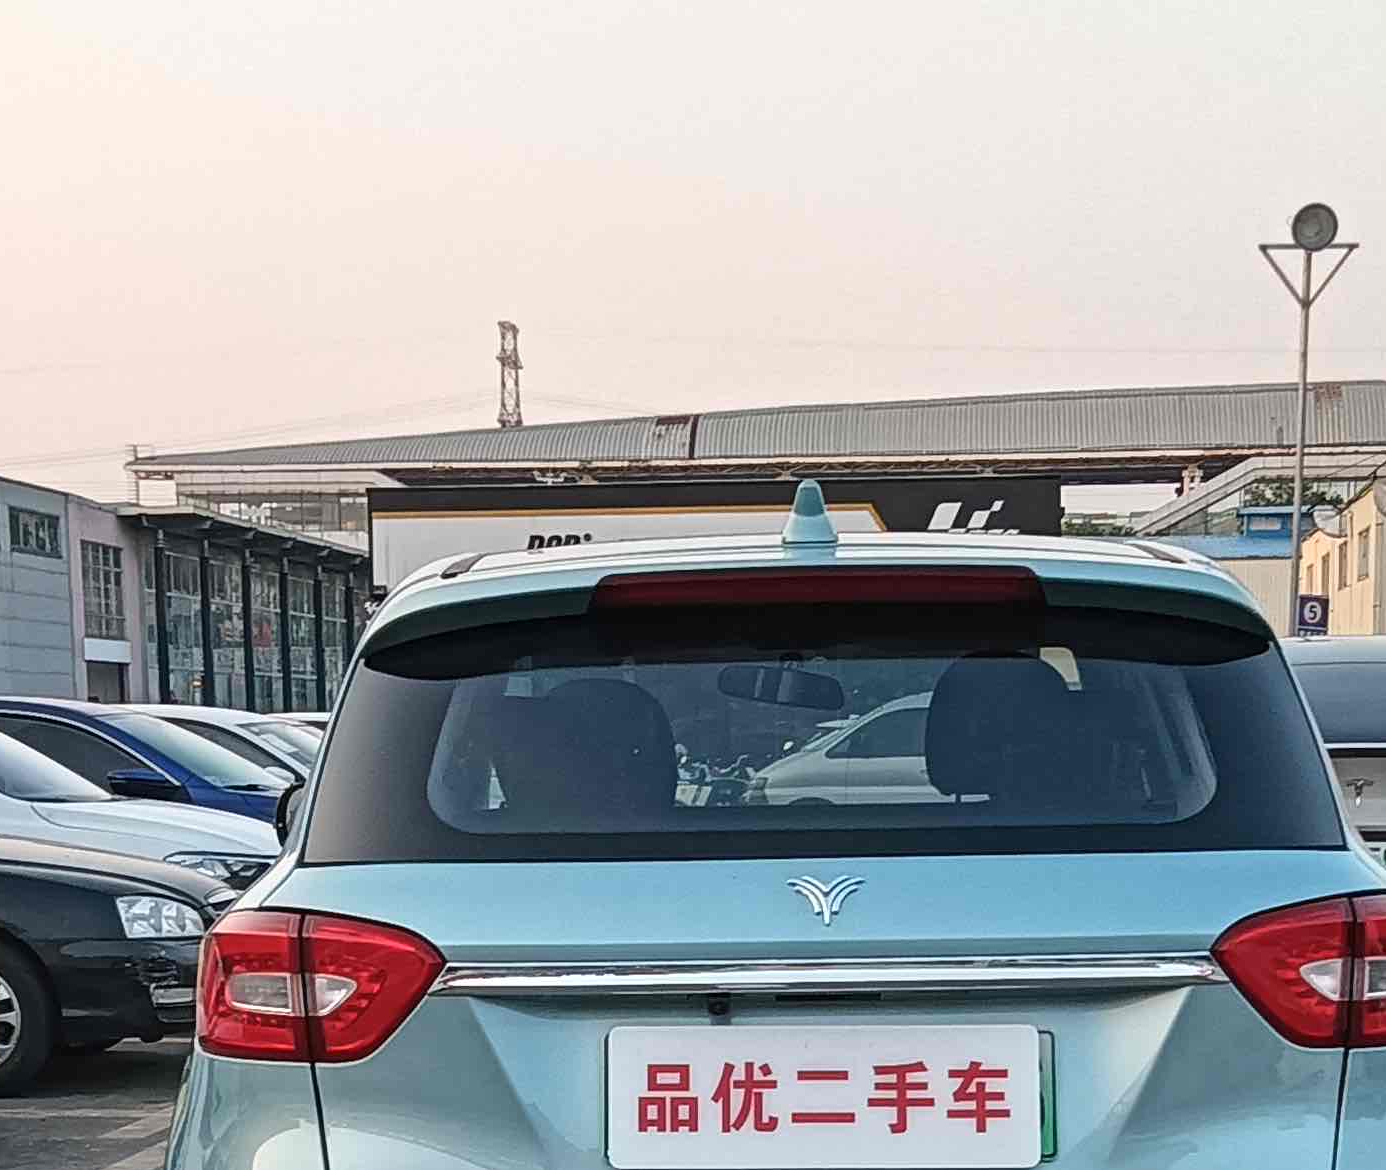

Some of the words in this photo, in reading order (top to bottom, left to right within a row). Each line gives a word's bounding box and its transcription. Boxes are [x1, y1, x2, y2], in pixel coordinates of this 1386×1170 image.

[638, 1061, 1011, 1133] 品优二手车
